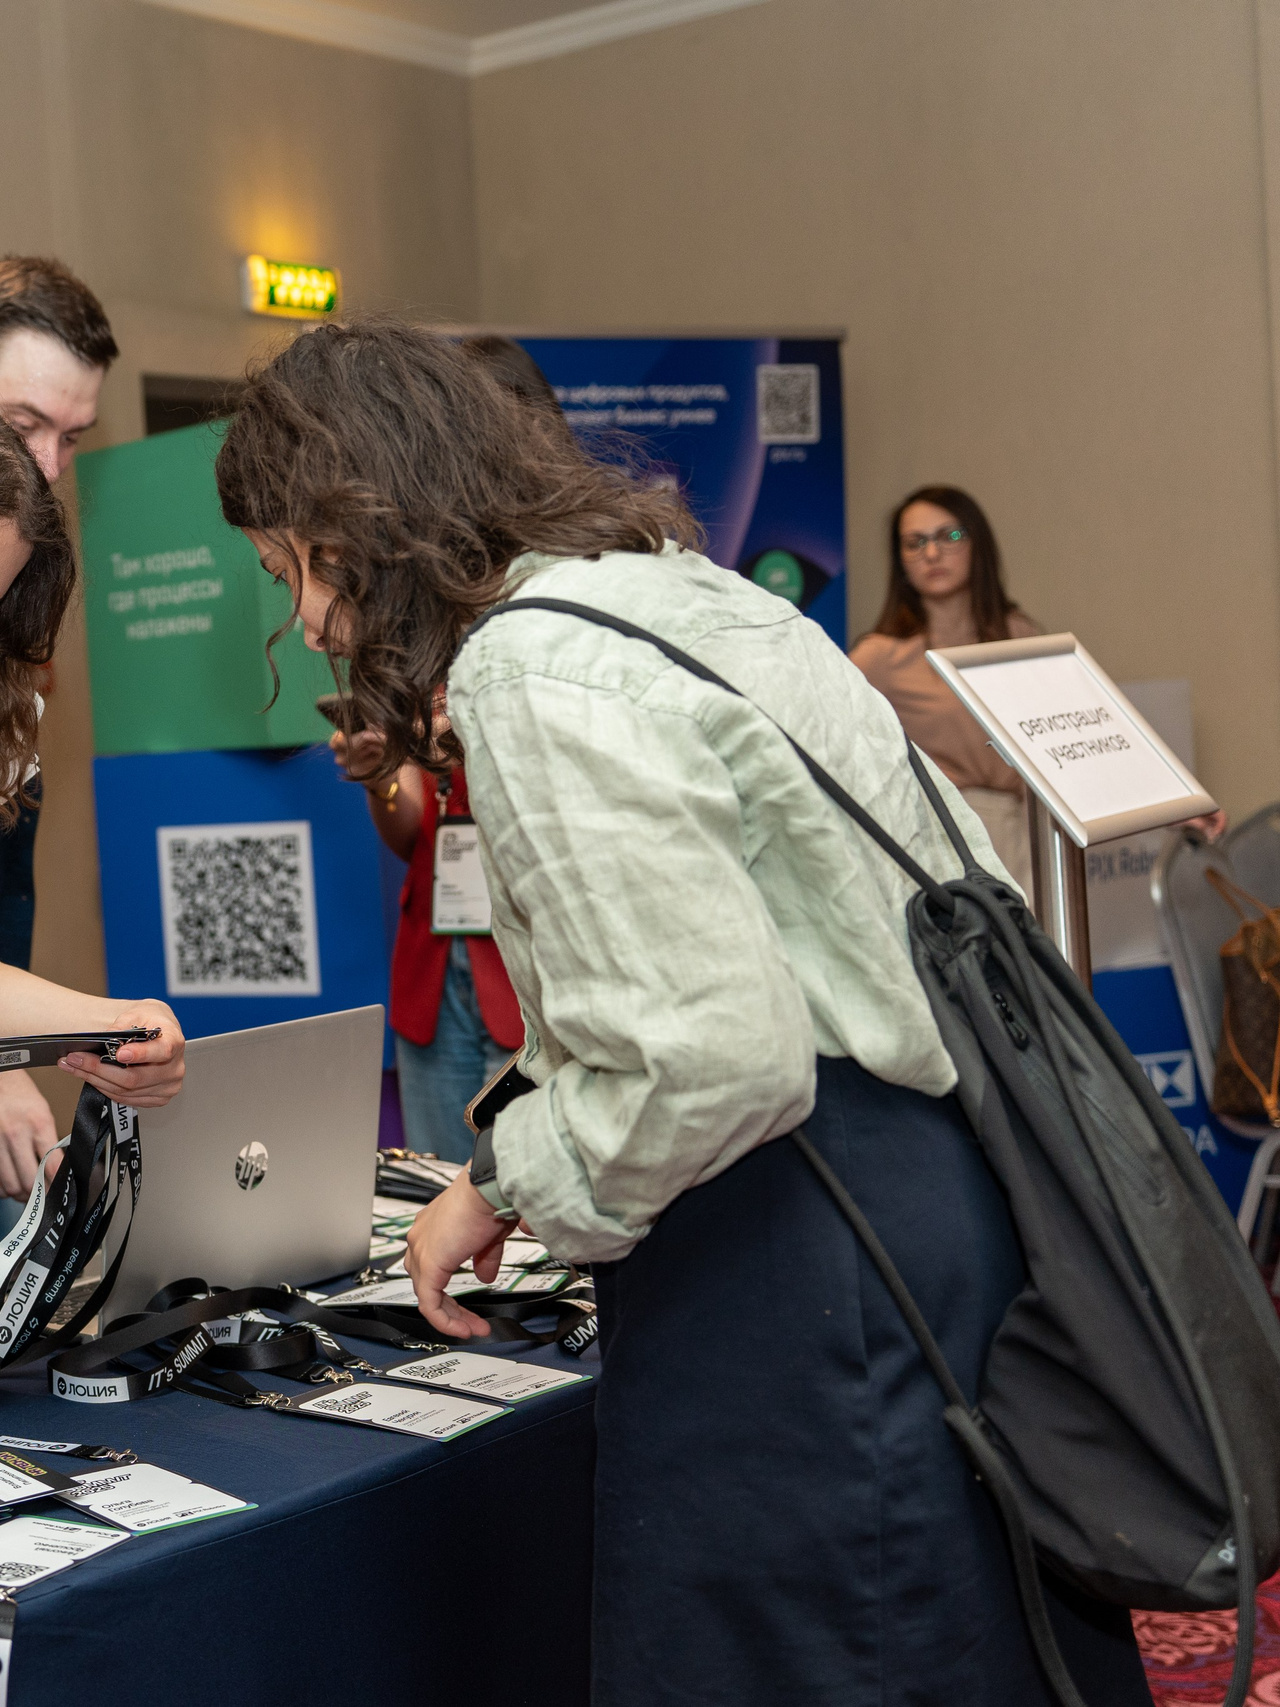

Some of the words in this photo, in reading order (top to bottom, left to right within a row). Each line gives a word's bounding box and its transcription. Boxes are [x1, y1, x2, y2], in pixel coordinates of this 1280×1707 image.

[1018, 706, 1114, 742] регистрация
[1045, 734, 1130, 769] участников
[18, 1182, 43, 1242] по-новому
[63, 1245, 80, 1275] geek
[44, 1272, 67, 1304] camp
[147, 1366, 174, 1392] IT's
[172, 1330, 210, 1374] SUMMIT
